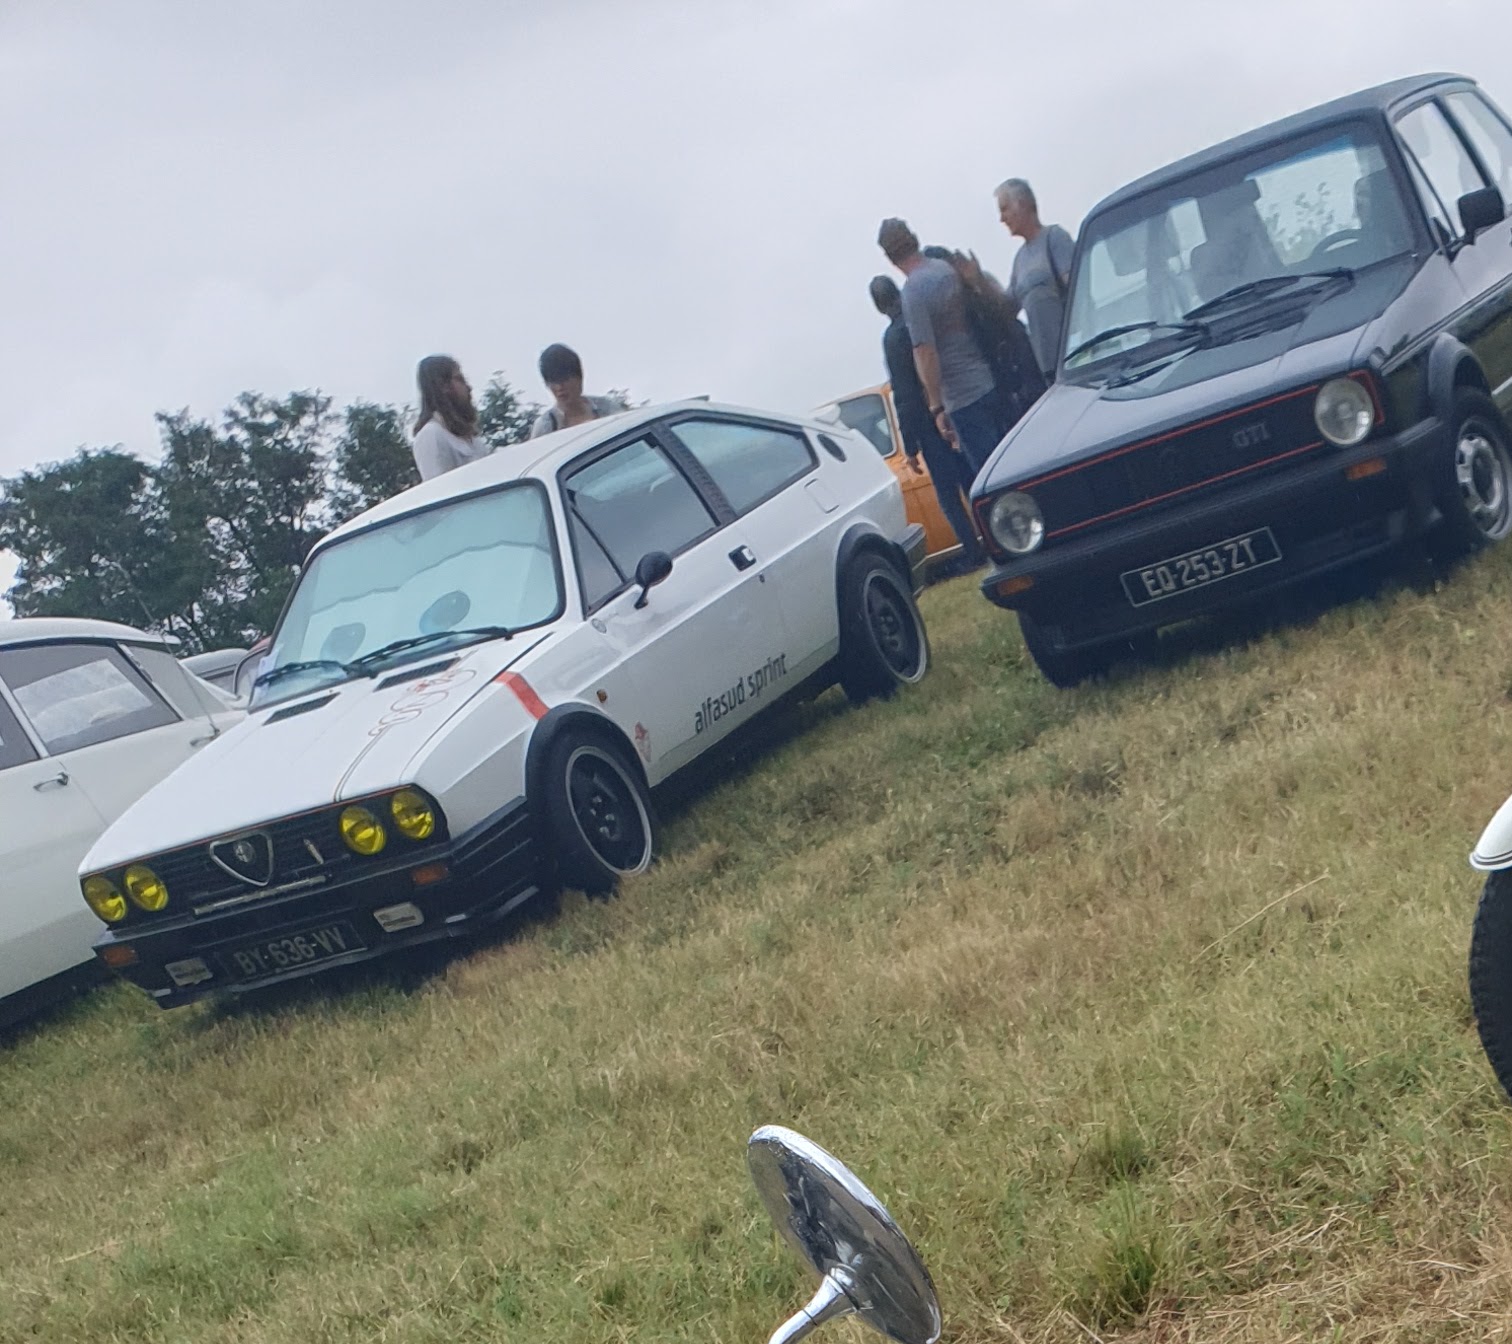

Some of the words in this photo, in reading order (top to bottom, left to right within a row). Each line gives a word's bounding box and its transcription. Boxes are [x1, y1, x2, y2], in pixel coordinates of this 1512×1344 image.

[1232, 423, 1270, 448] GTI
[1140, 538, 1256, 596] EQ-253-ZT
[695, 677, 746, 734] alfasud
[747, 653, 787, 698] sprint
[233, 927, 346, 974] BY-636-VV
